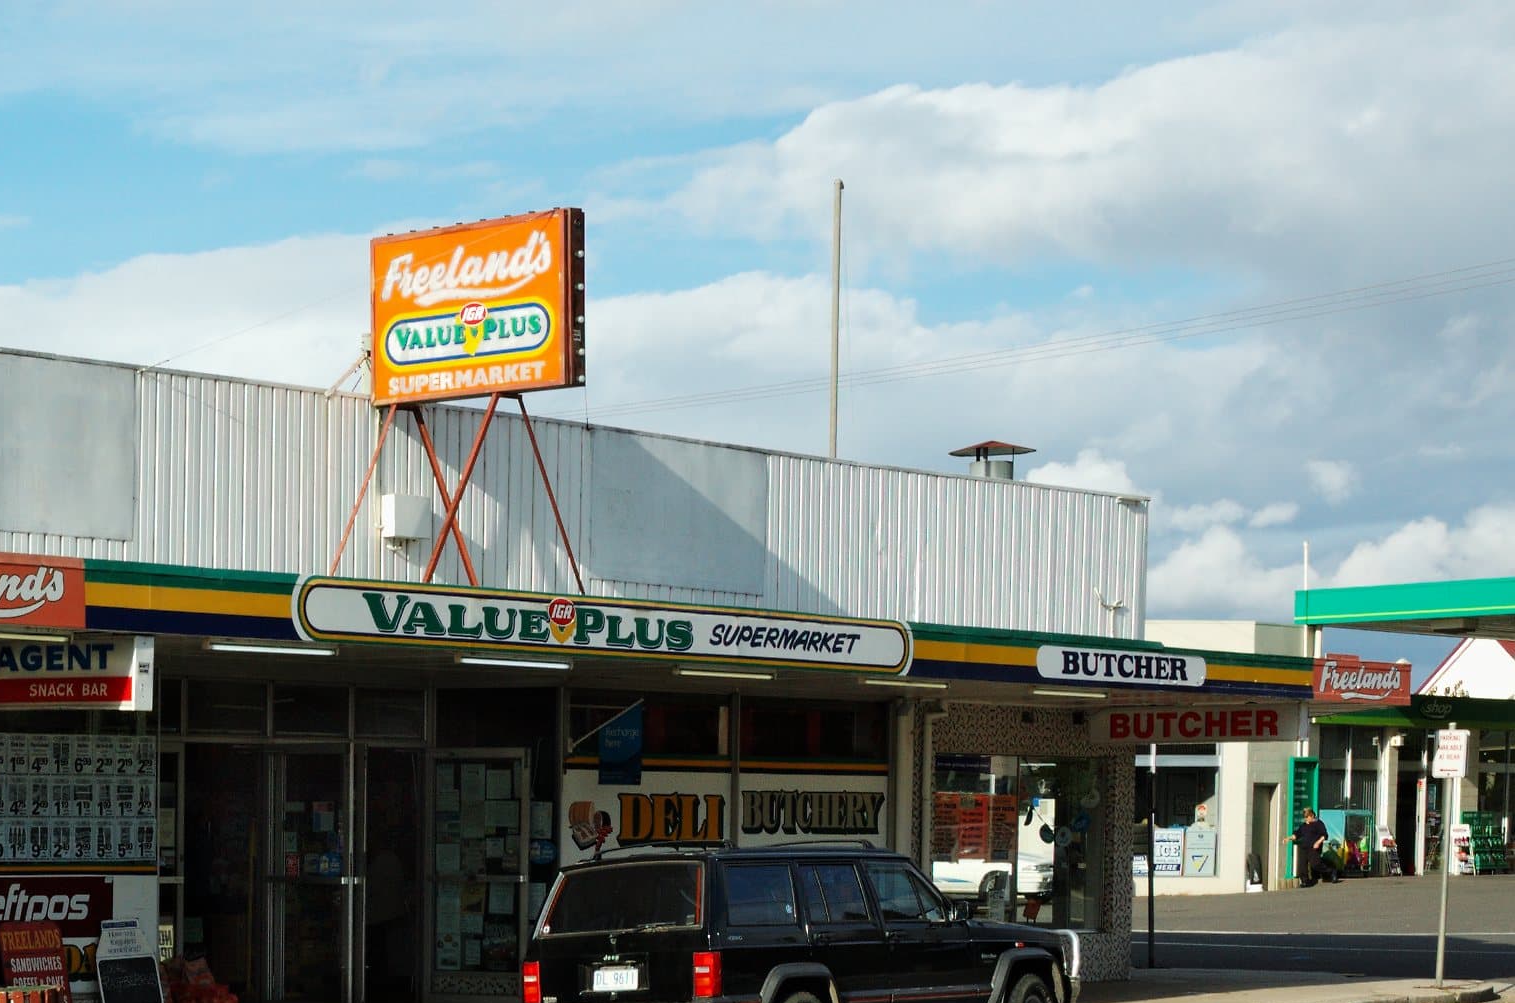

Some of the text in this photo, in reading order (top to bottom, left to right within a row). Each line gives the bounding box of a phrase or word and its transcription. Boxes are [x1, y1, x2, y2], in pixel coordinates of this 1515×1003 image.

[382, 230, 551, 301] Freeland's
[463, 306, 485, 321] IGA
[395, 315, 541, 350] VALUE PLUS
[388, 361, 546, 395] SUPERMARKET
[362, 592, 860, 655] VALUE PLUS SUPERMARKET
[551, 602, 572, 620] IGA
[1062, 651, 1188, 681] BUTCHER
[1320, 661, 1401, 692] Freeland's
[29, 683, 74, 697] SNACK
[82, 683, 108, 696] BAR
[1110, 710, 1278, 739] BUTCHER
[618, 792, 726, 846] DELI
[742, 789, 885, 834] BUTCHERY
[0, 929, 61, 951] FREELANDS
[11, 956, 63, 973] SANDWICHES
